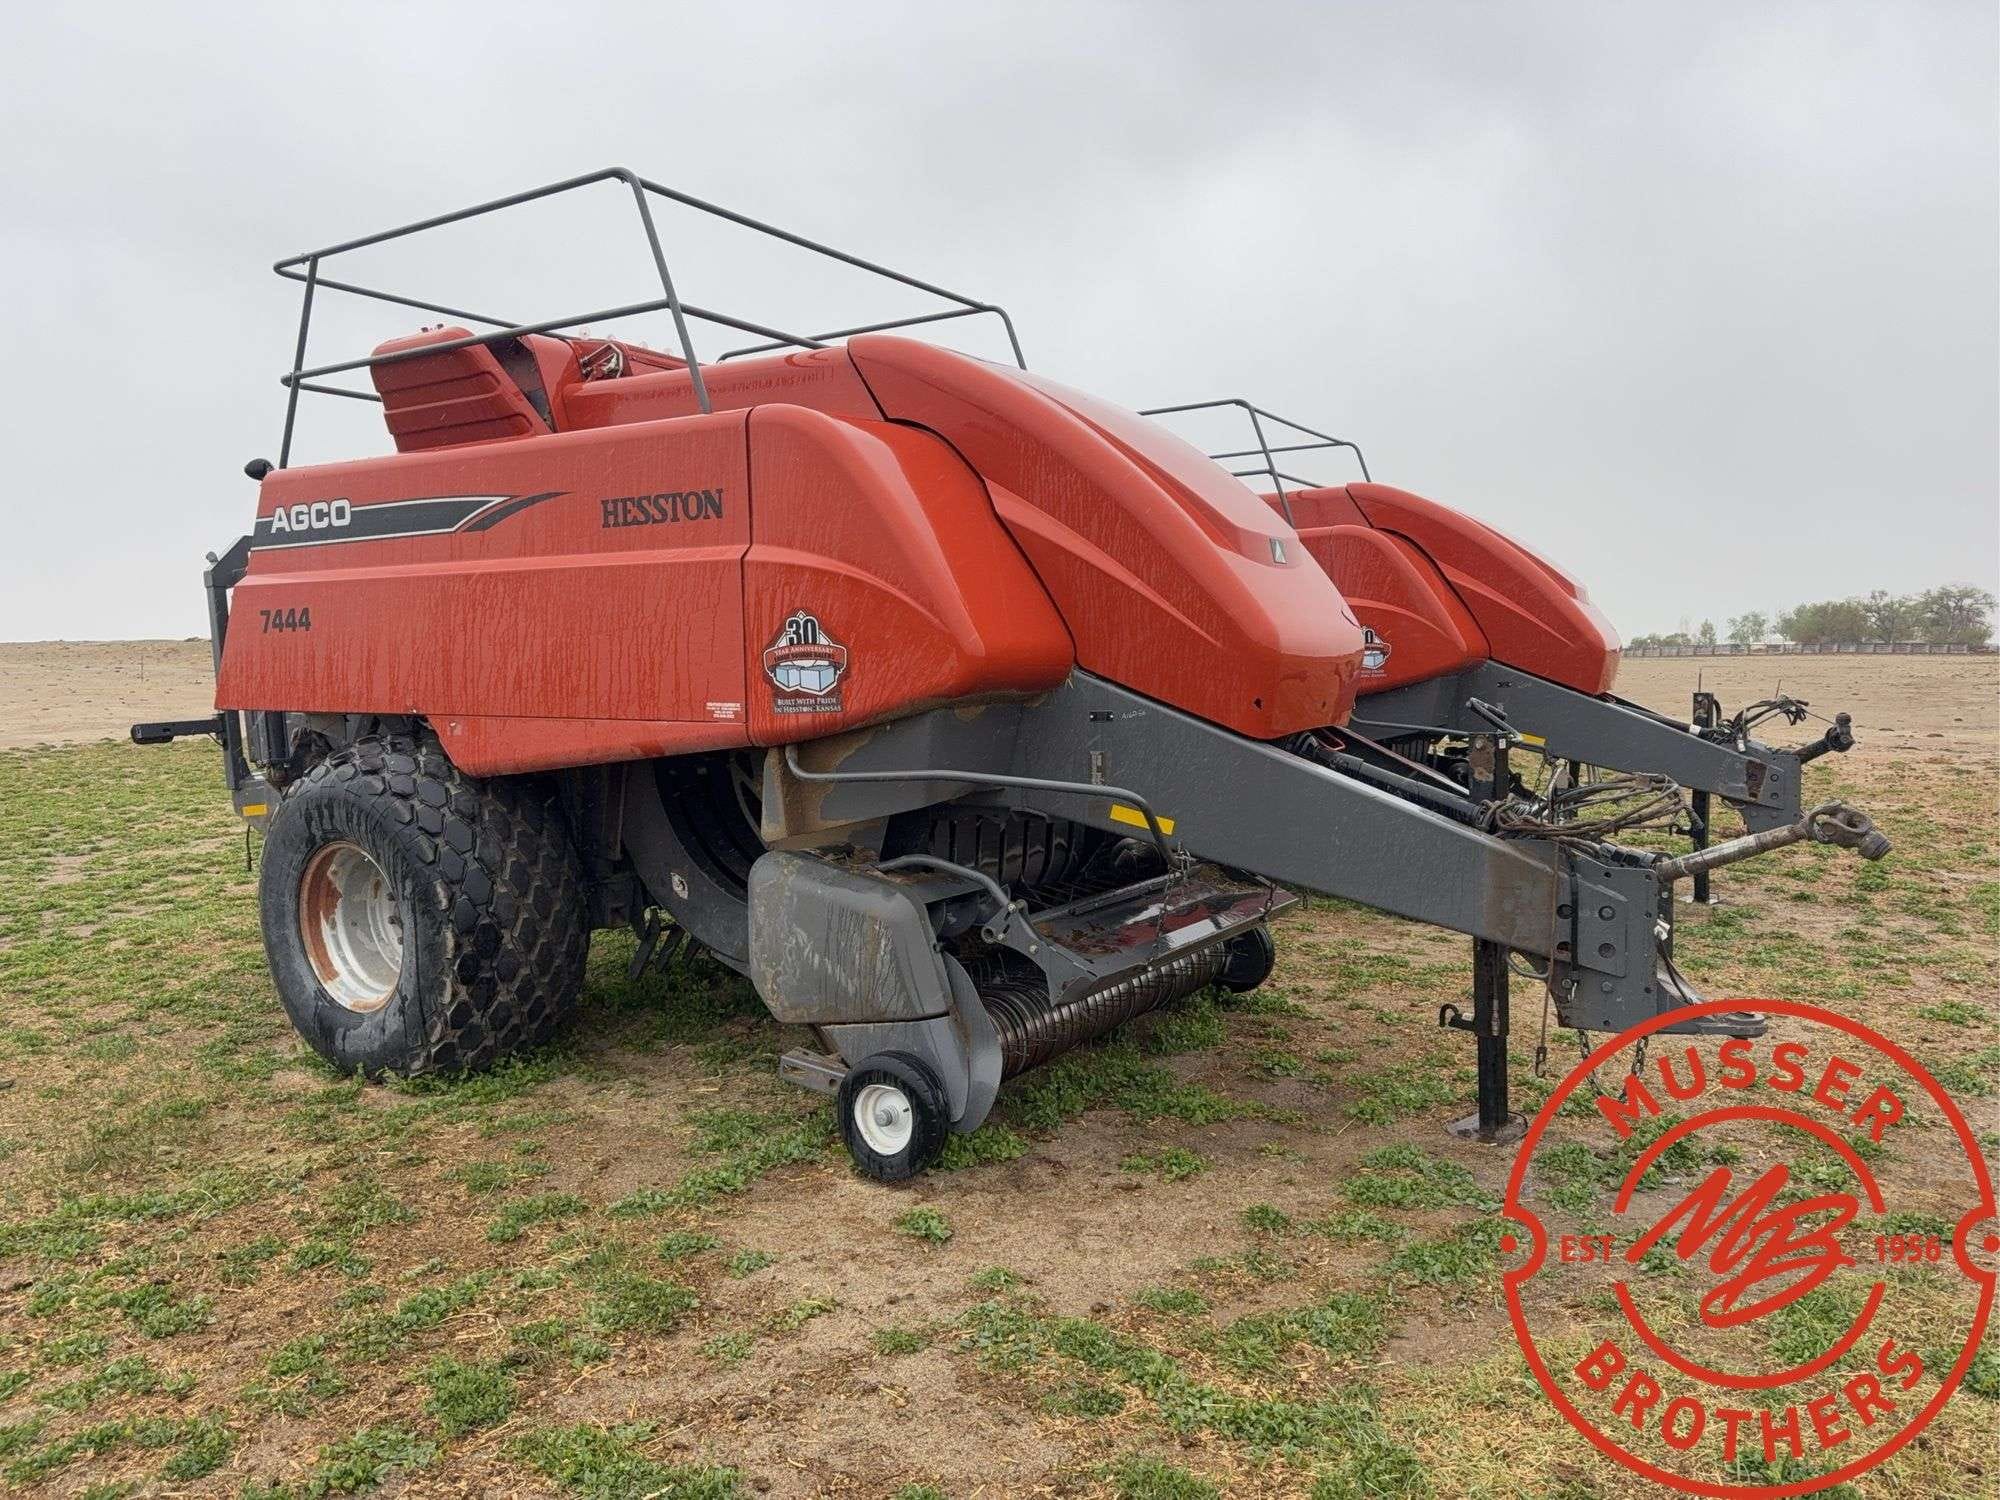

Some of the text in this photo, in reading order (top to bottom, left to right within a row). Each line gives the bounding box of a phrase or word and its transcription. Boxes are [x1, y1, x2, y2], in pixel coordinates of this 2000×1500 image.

[270, 498, 352, 534] AGCO
[600, 488, 724, 529] HESSTON
[260, 607, 312, 633] 7444
[787, 618, 817, 645] 30
[775, 647, 790, 656] YEAR
[790, 645, 834, 654] ANNIVERSARY
